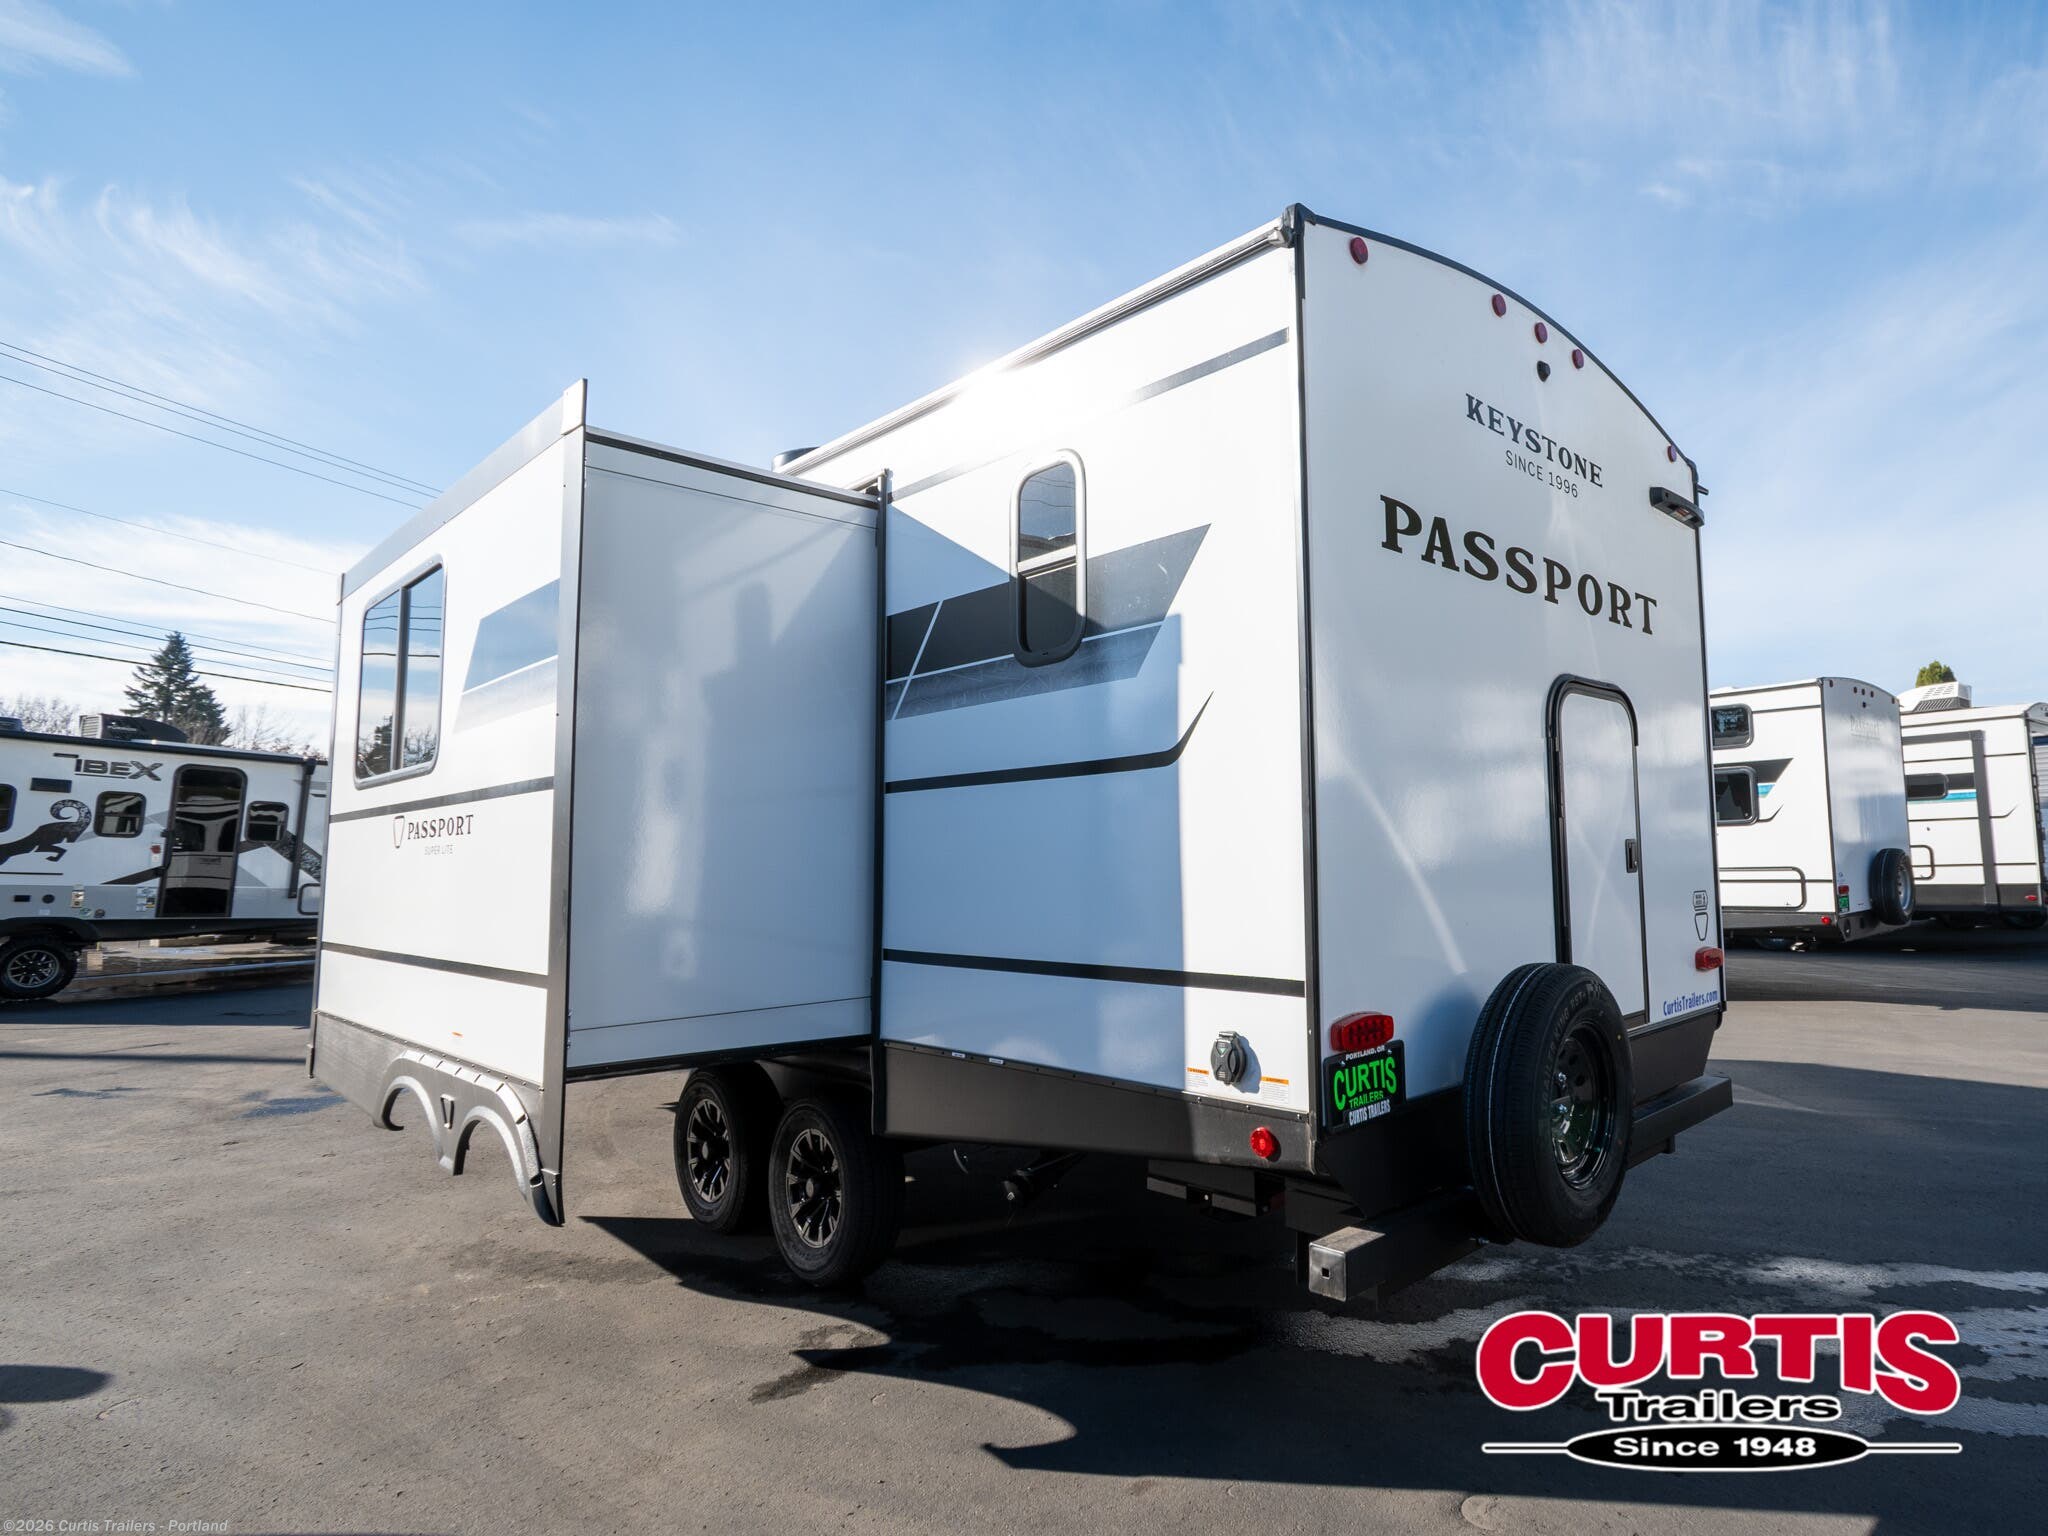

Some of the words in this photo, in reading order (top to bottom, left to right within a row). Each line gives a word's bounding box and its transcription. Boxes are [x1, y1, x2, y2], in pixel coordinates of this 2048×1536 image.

[1465, 393, 1603, 488] KEYSTONE
[1505, 450, 1543, 482] SINCE
[1548, 472, 1579, 499] 1996
[1380, 494, 1658, 636] PASSPORT
[74, 758, 163, 782] IBEX
[407, 814, 474, 840] PASSPORT
[1663, 990, 1718, 1016] CurtisTrailers.com
[1334, 1056, 1397, 1111] CURTIS
[1349, 1090, 1384, 1109] TRAILERS
[1349, 1107, 1368, 1127] CURTIS
[1368, 1098, 1391, 1119] TRAILERS
